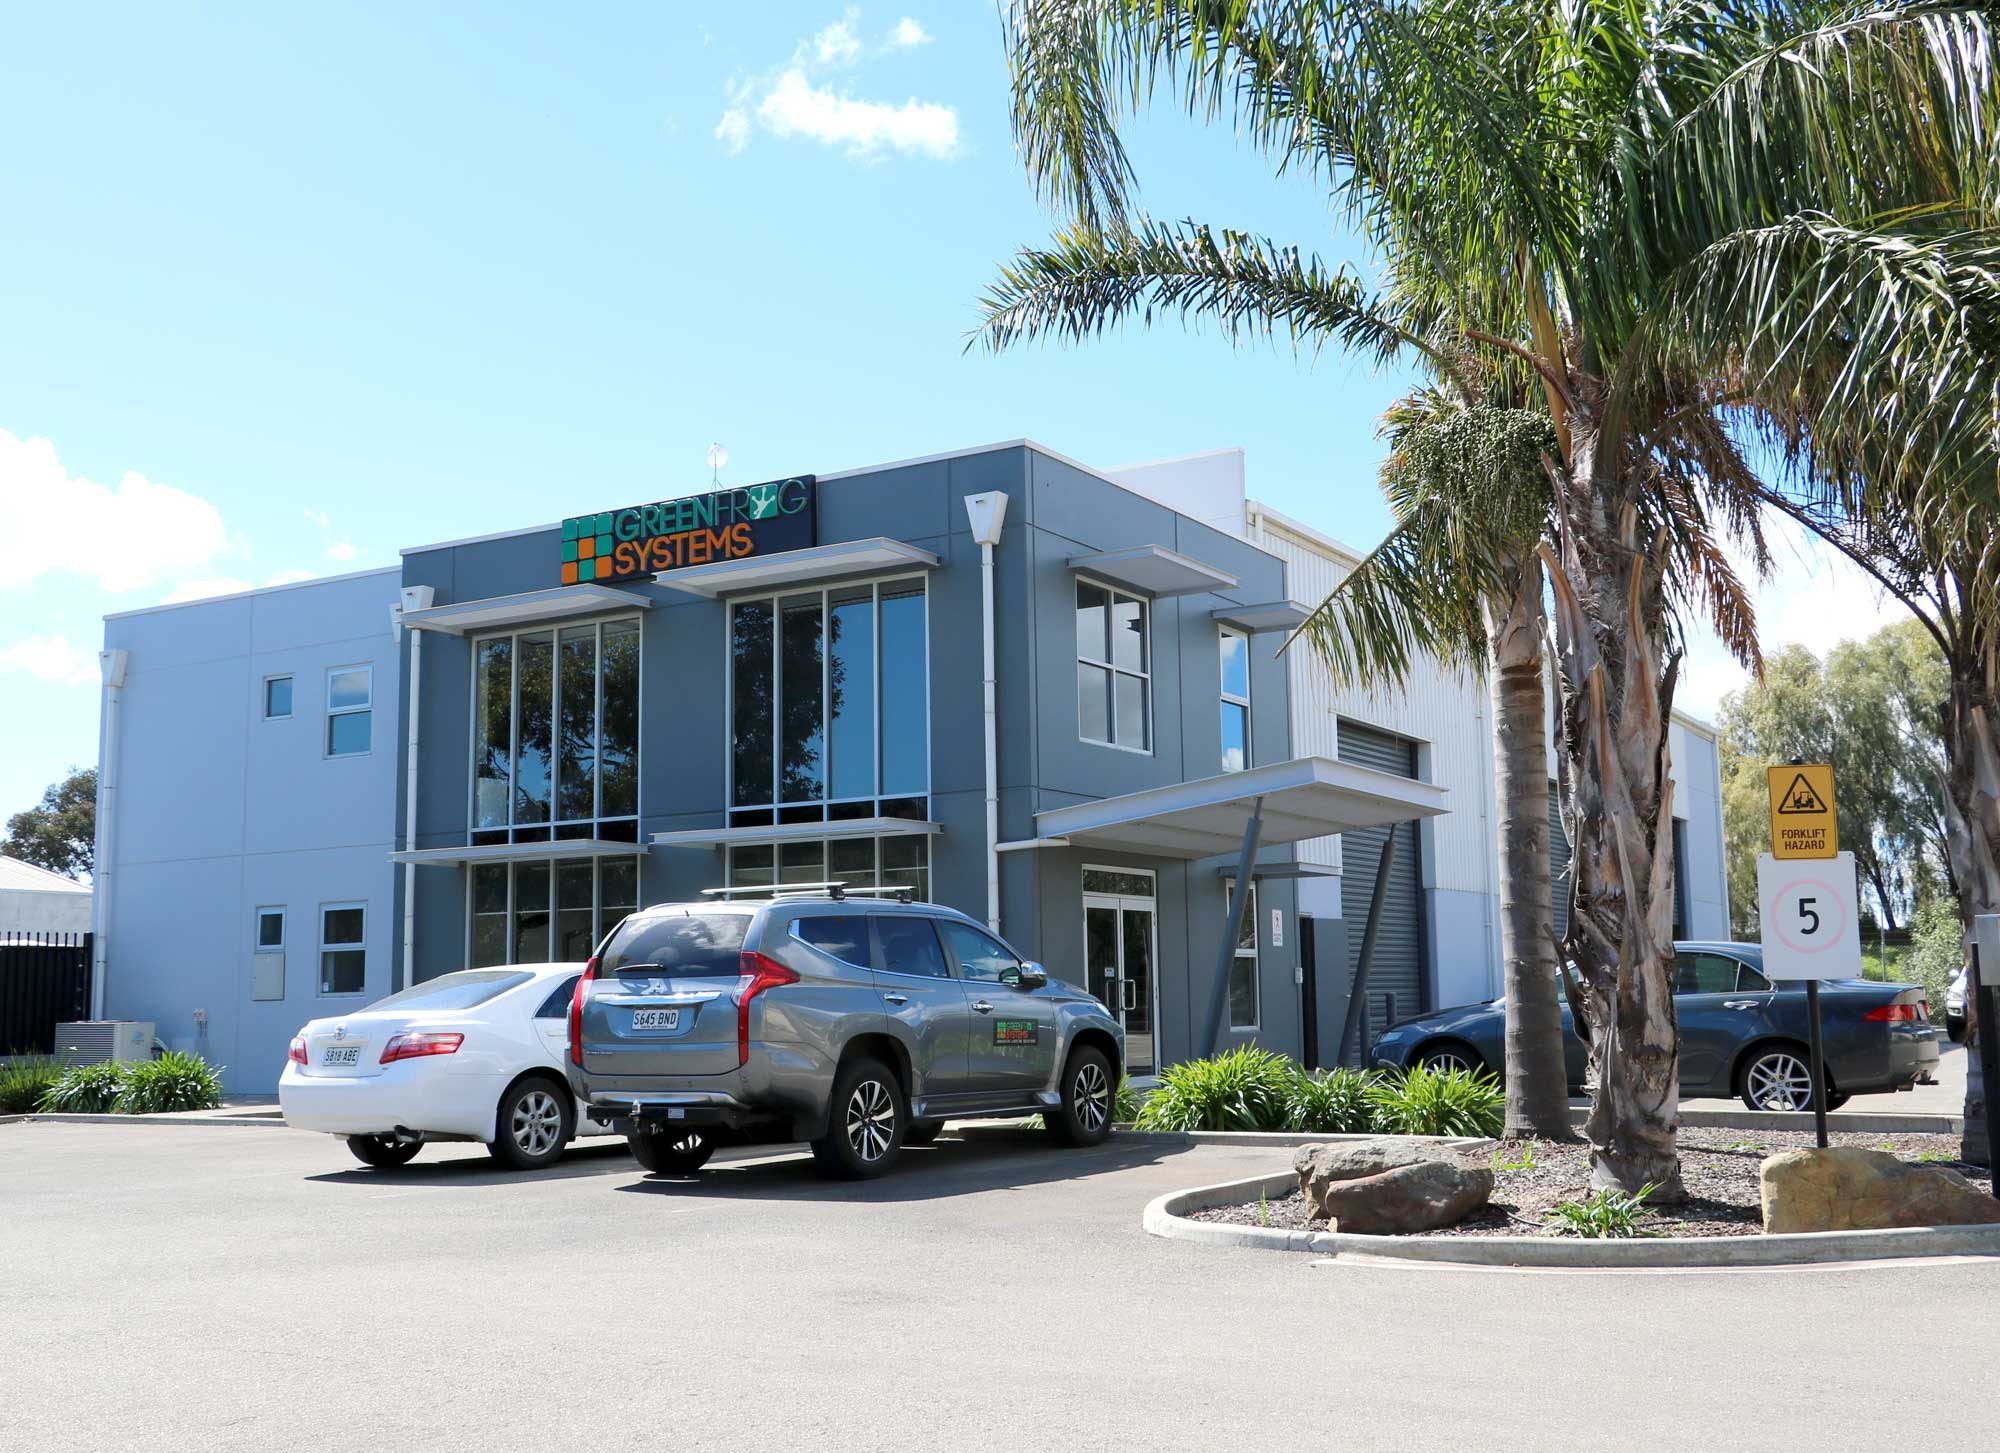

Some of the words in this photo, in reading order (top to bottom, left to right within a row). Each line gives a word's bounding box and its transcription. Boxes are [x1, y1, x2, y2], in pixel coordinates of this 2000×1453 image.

[614, 479, 808, 542] GREENFRG
[615, 522, 754, 575] SYSTEMS
[1781, 828, 1827, 839] FORKLIFT
[1784, 840, 1825, 850] HAZARD
[1798, 897, 1820, 935] 5
[633, 1012, 656, 1025] S645
[657, 1012, 677, 1025] BND
